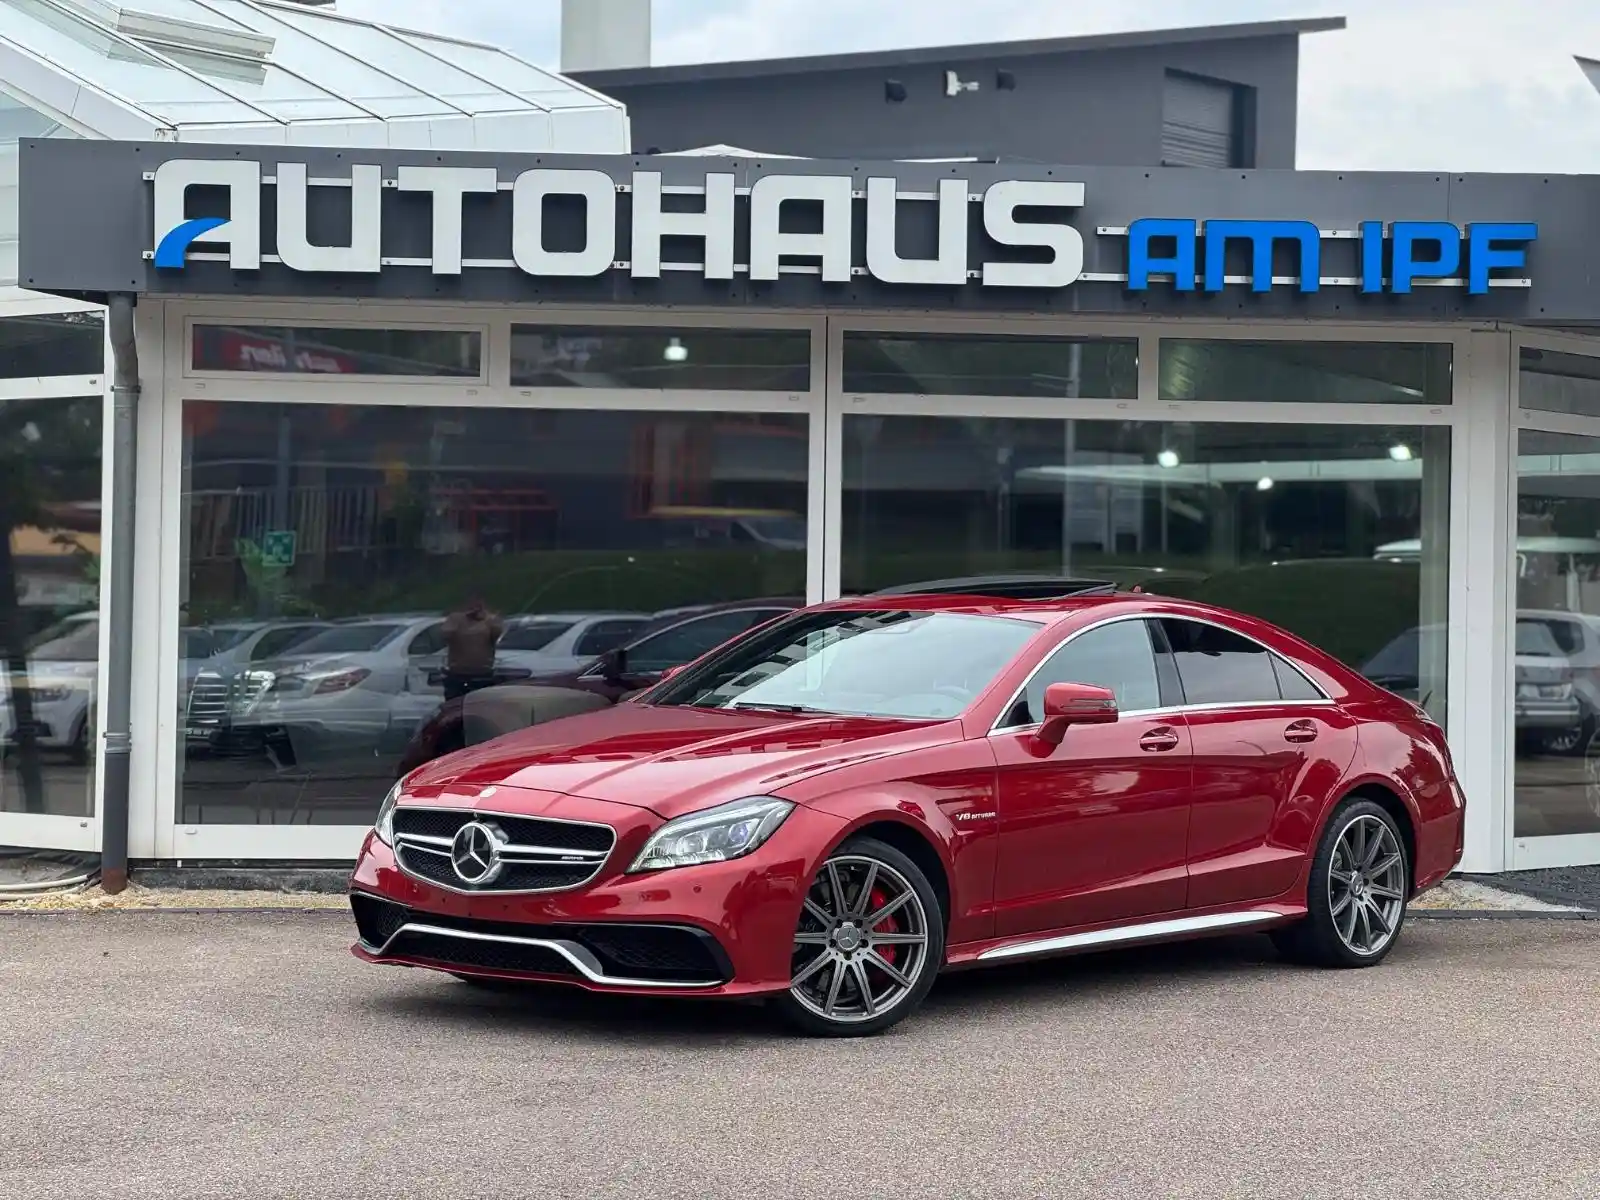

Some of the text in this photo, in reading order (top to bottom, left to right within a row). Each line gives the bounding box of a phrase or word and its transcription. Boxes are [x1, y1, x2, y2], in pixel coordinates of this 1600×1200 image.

[153, 158, 1539, 295] AUTOHAUS AM IPF
